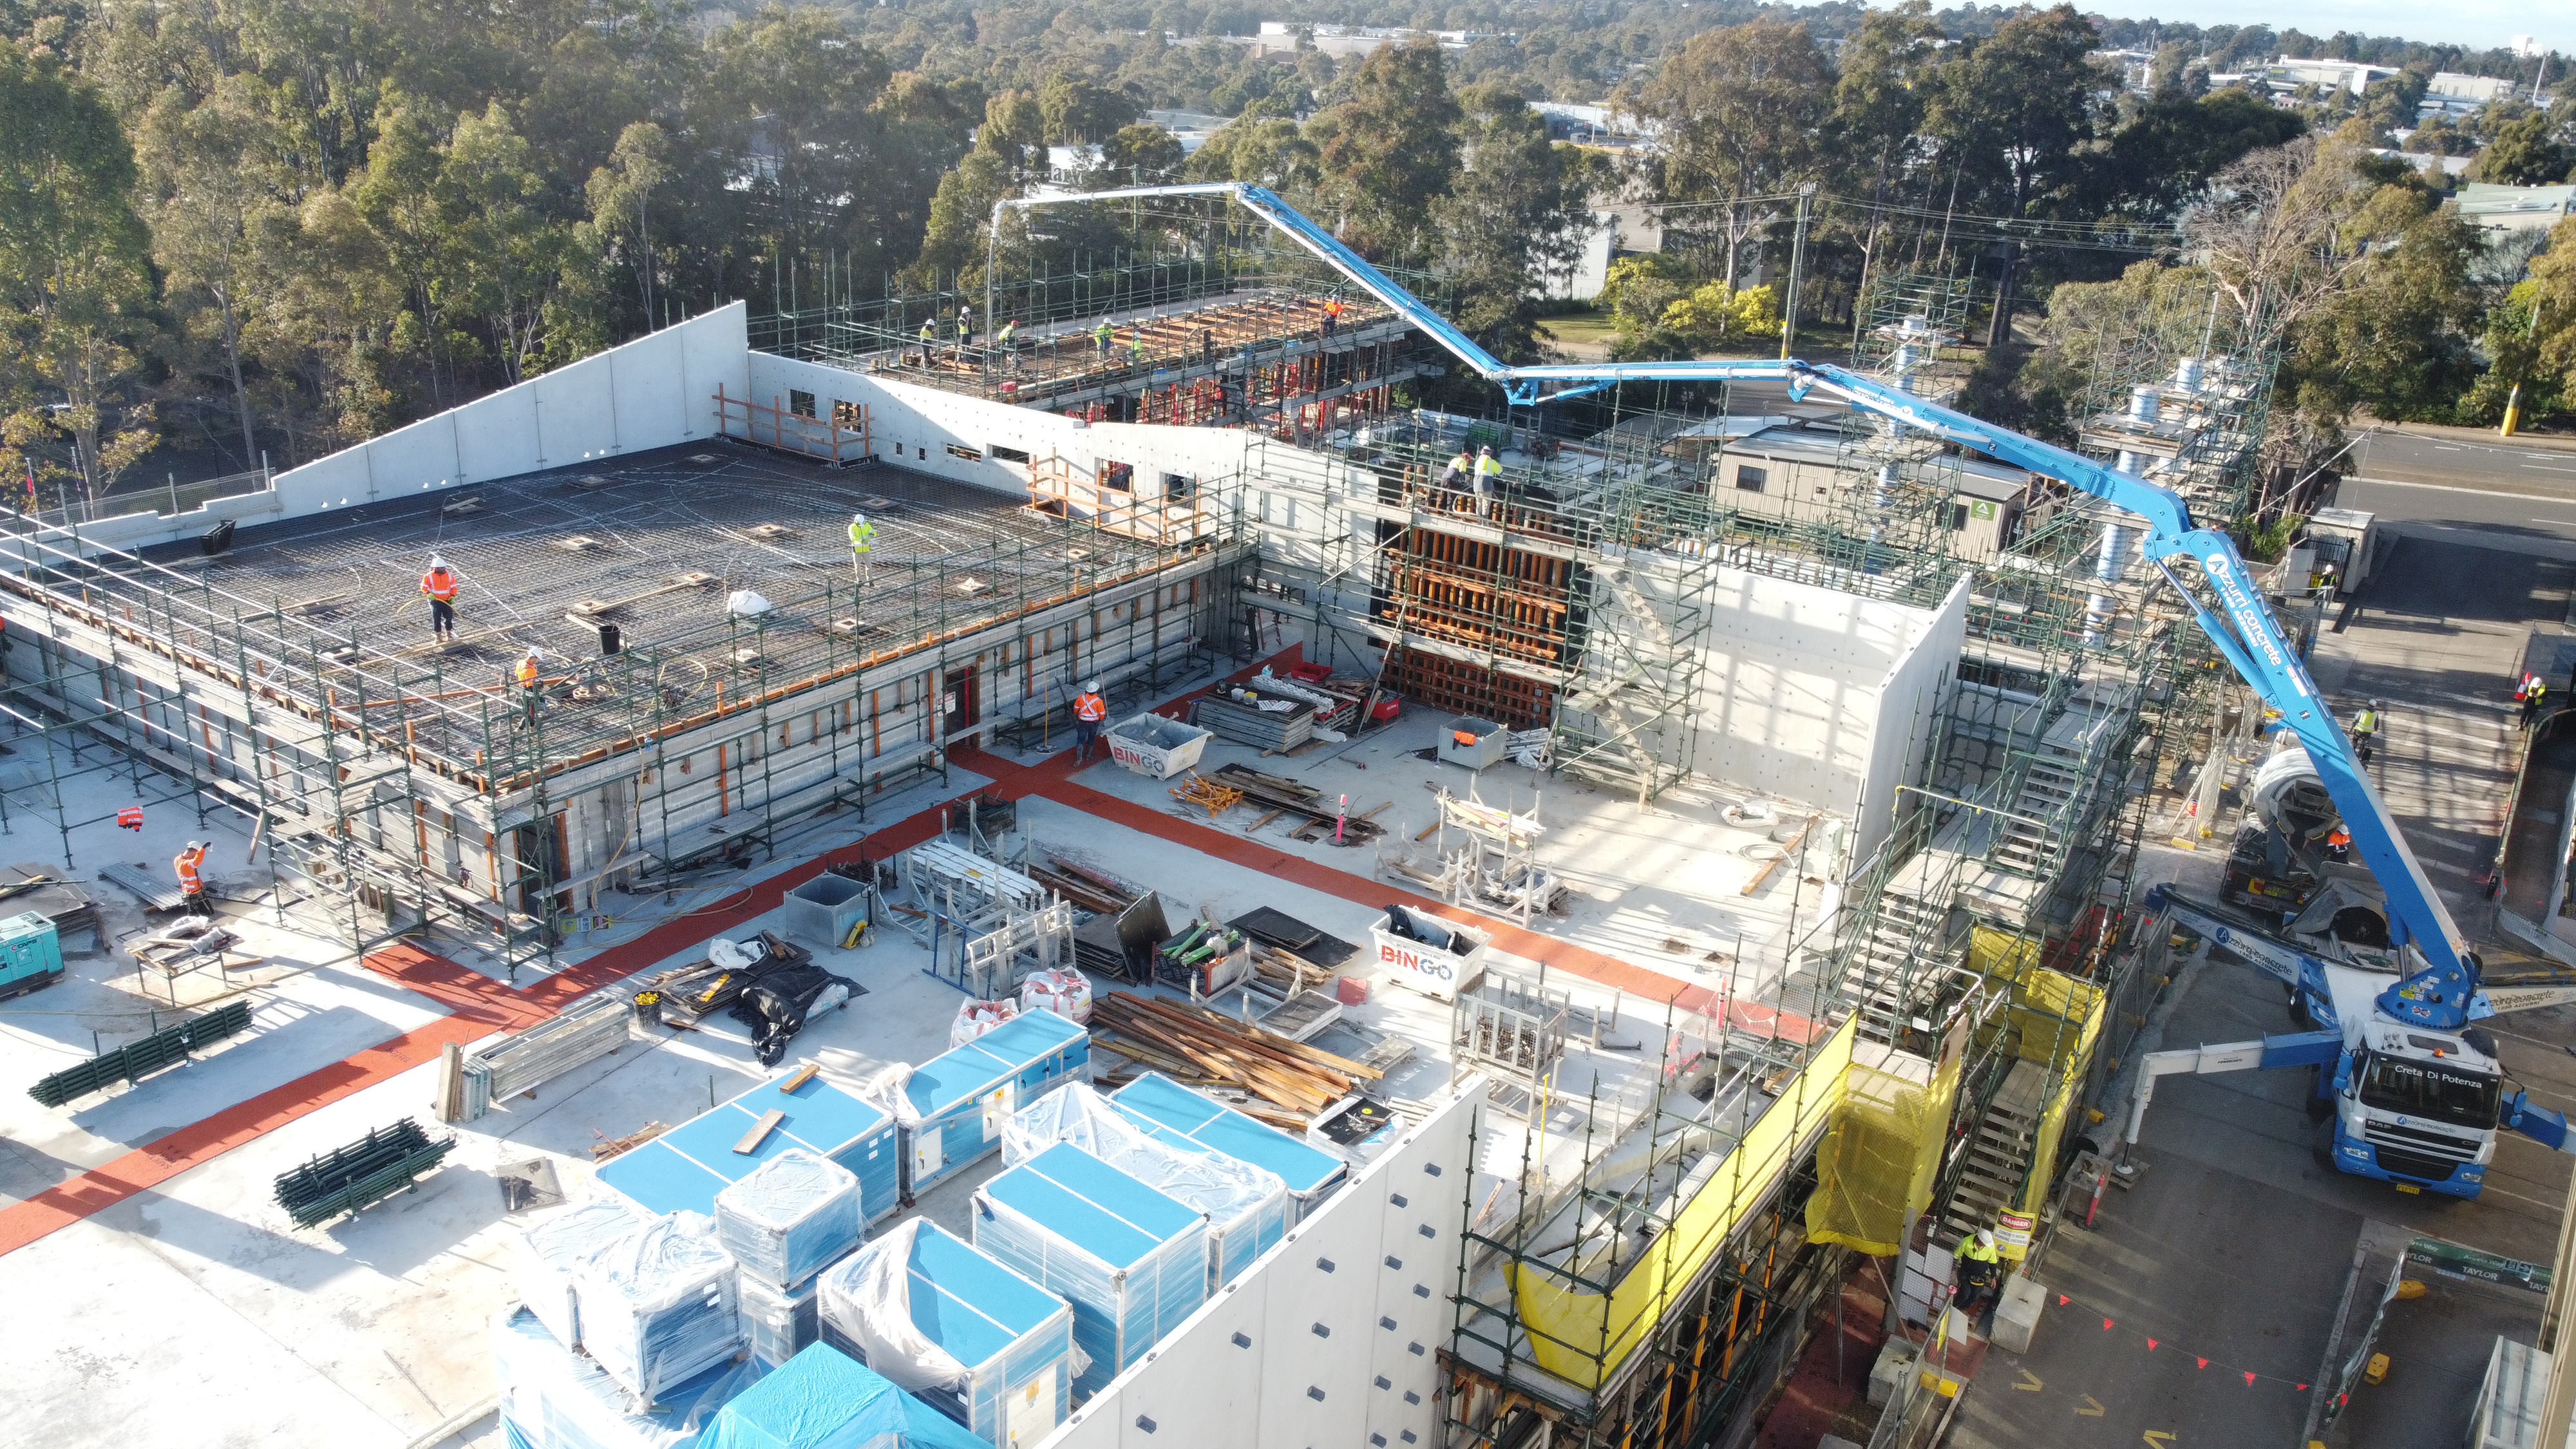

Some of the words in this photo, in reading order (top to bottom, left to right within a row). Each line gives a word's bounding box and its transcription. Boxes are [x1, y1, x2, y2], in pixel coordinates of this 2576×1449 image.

[2206, 554, 2251, 608] Azzurri
[2242, 609, 2282, 666] concrete
[2219, 586, 2235, 609] 1300
[2233, 610, 2260, 648] AZZURRI
[1113, 747, 1165, 773] BINGO
[1381, 945, 1452, 981] BINGO
[2216, 927, 2253, 955] Azzurri
[2254, 949, 2293, 976] concrete
[2239, 950, 2253, 960] 1300
[2254, 958, 2279, 974] AZZURRI
[2513, 990, 2555, 1003] concrete
[2394, 1065, 2423, 1077] Creta
[2427, 1070, 2439, 1080] Di
[2442, 1074, 2482, 1088] Potenza
[2367, 1120, 2392, 1130] DAF
[2002, 1217, 2029, 1227] DANGER
[2462, 1265, 2498, 1281] TAYLOR
